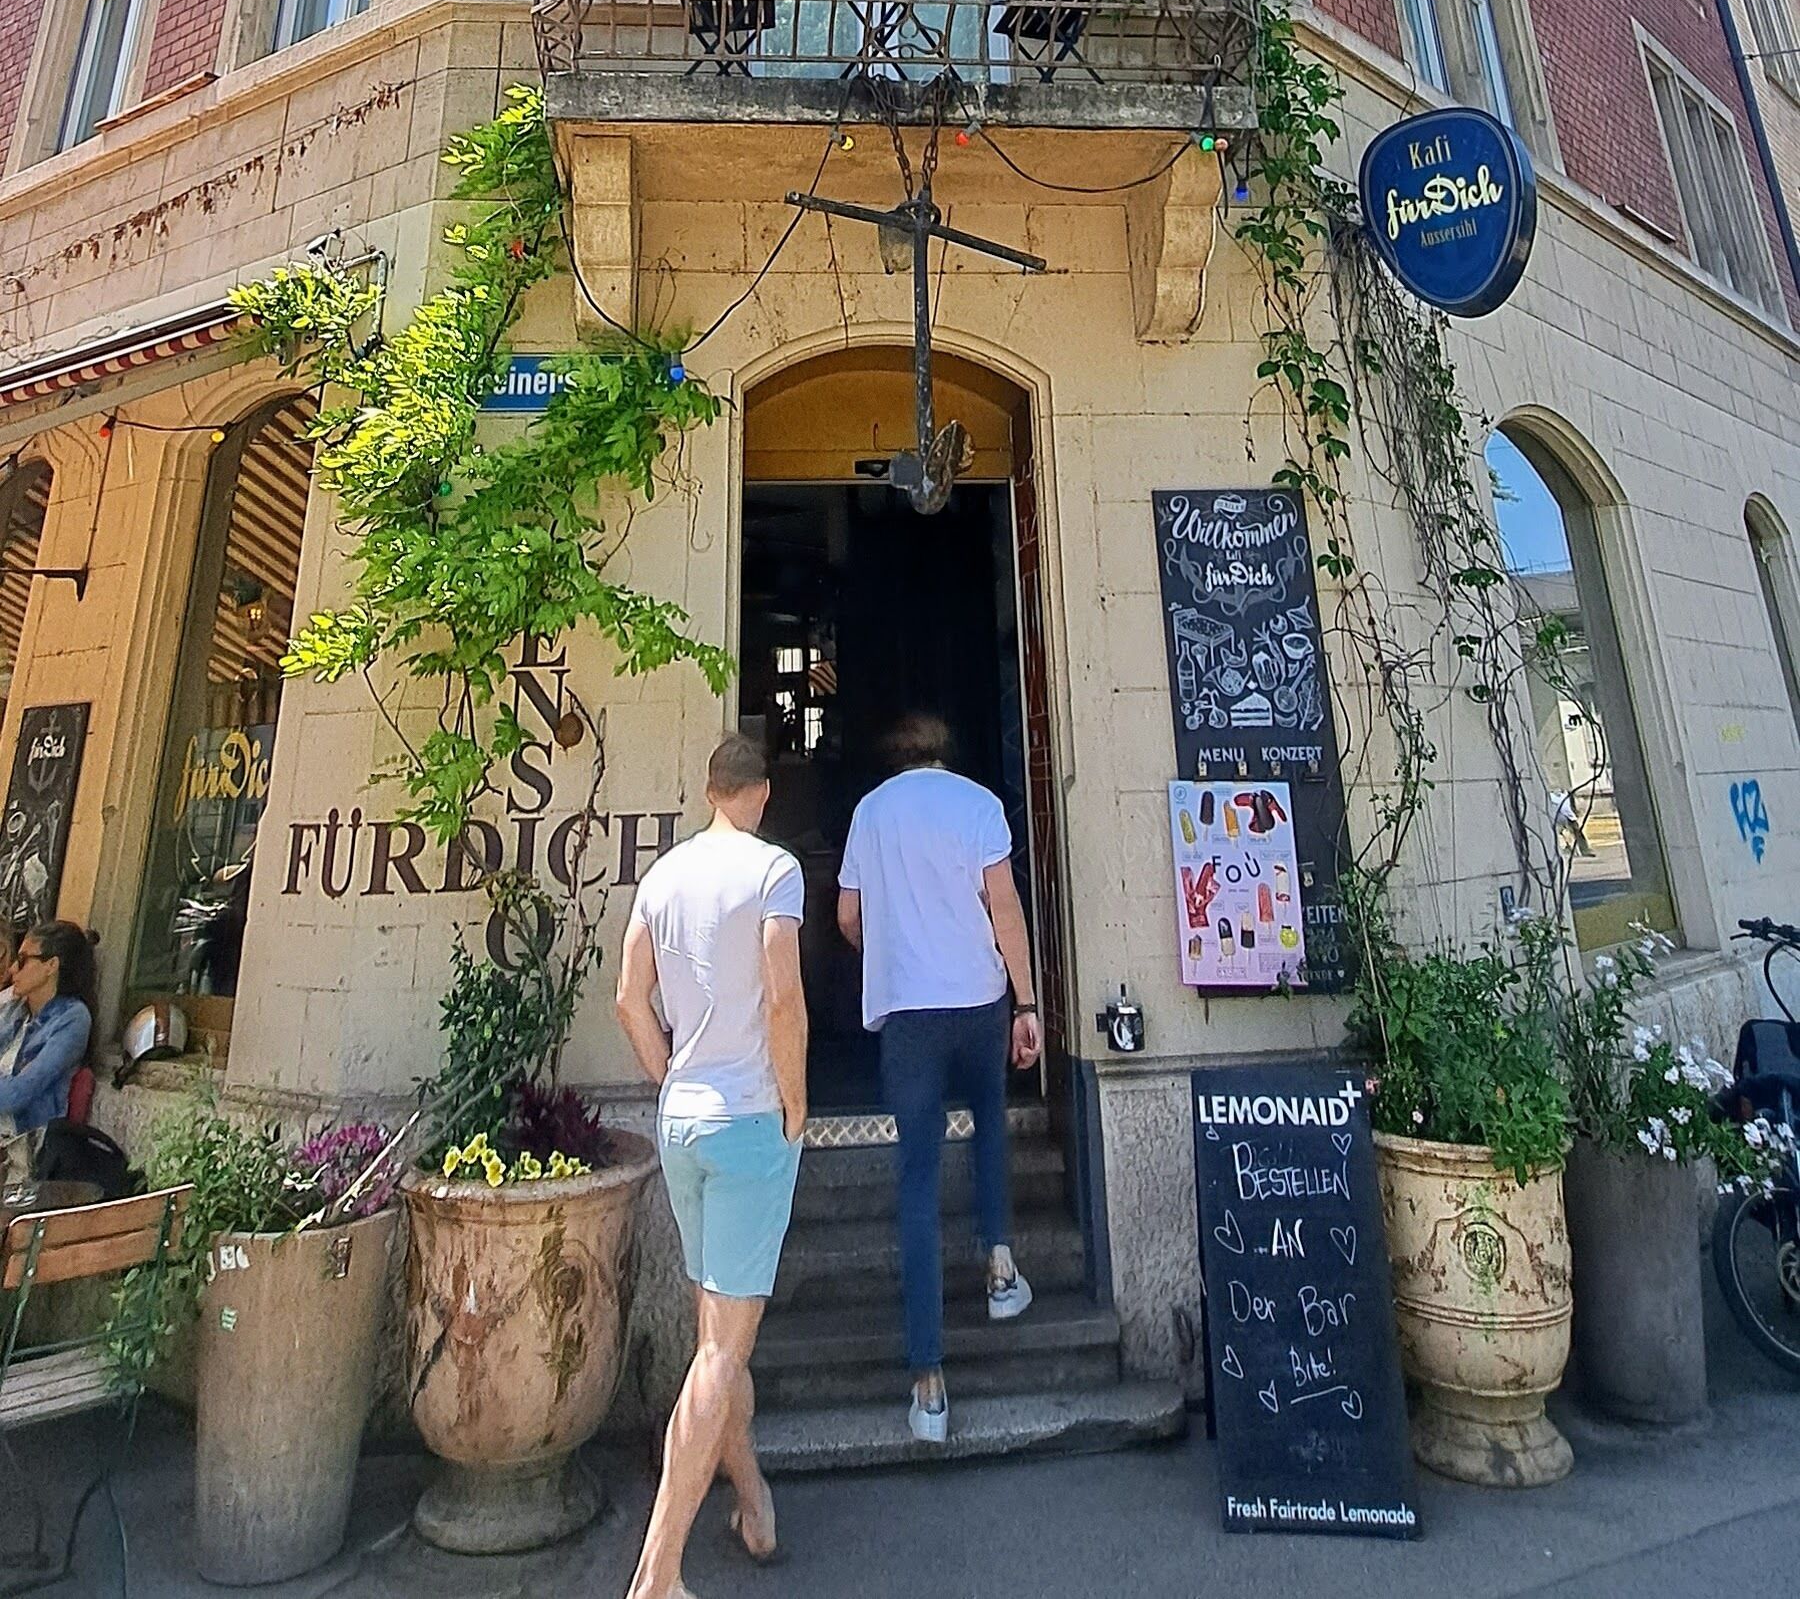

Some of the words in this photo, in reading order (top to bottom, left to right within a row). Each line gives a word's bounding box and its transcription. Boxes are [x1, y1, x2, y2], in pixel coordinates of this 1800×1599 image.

[1408, 134, 1452, 171] Kafi
[1420, 216, 1478, 249] Aussersihl
[1169, 493, 1299, 551] Willkommen
[1198, 747, 1245, 763] MENU
[1261, 746, 1323, 763] KONZERT
[1227, 1280, 1276, 1323] Der
[1297, 1285, 1356, 1336] Bar
[1227, 1496, 1267, 1519] Fresh
[1269, 1498, 1337, 1522] Fairtrade
[1340, 1500, 1416, 1525] Lemonade
